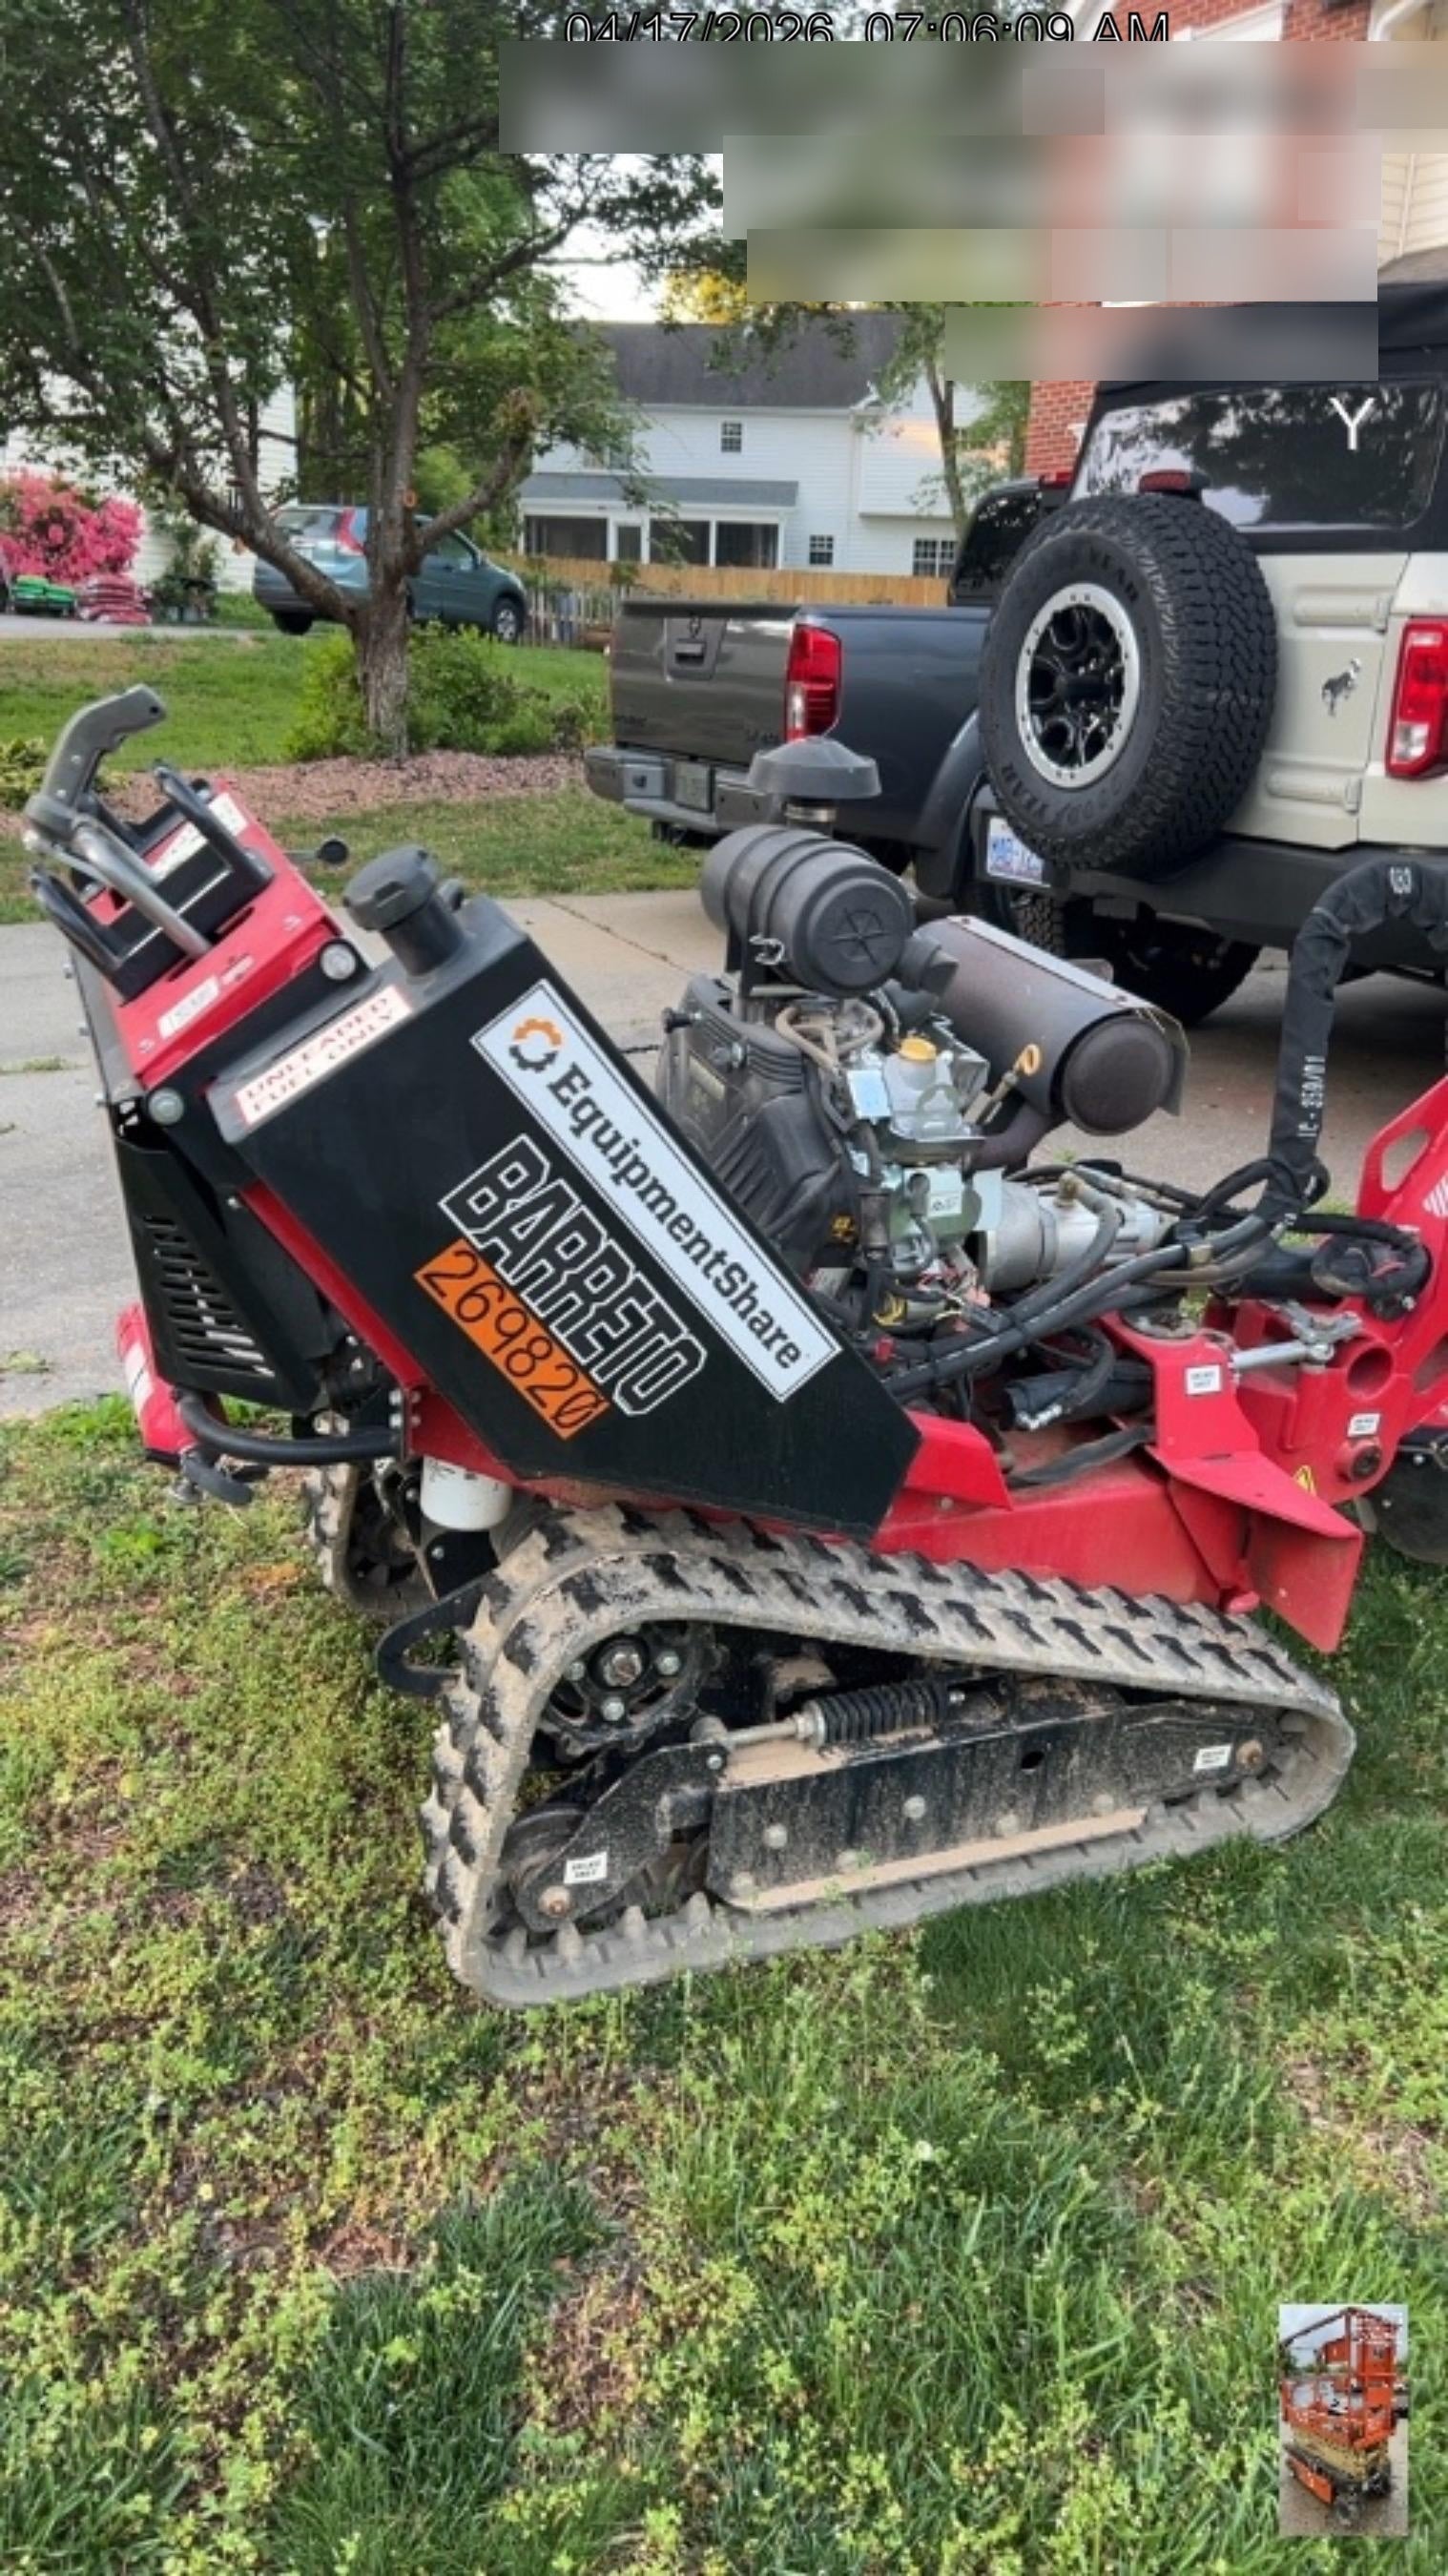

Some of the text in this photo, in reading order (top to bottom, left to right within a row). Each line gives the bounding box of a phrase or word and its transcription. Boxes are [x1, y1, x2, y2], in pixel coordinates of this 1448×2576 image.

[424, 1250, 607, 1430] 269820
[438, 1132, 708, 1417] BARRETO
[547, 1063, 801, 1370] EquipmentShare
